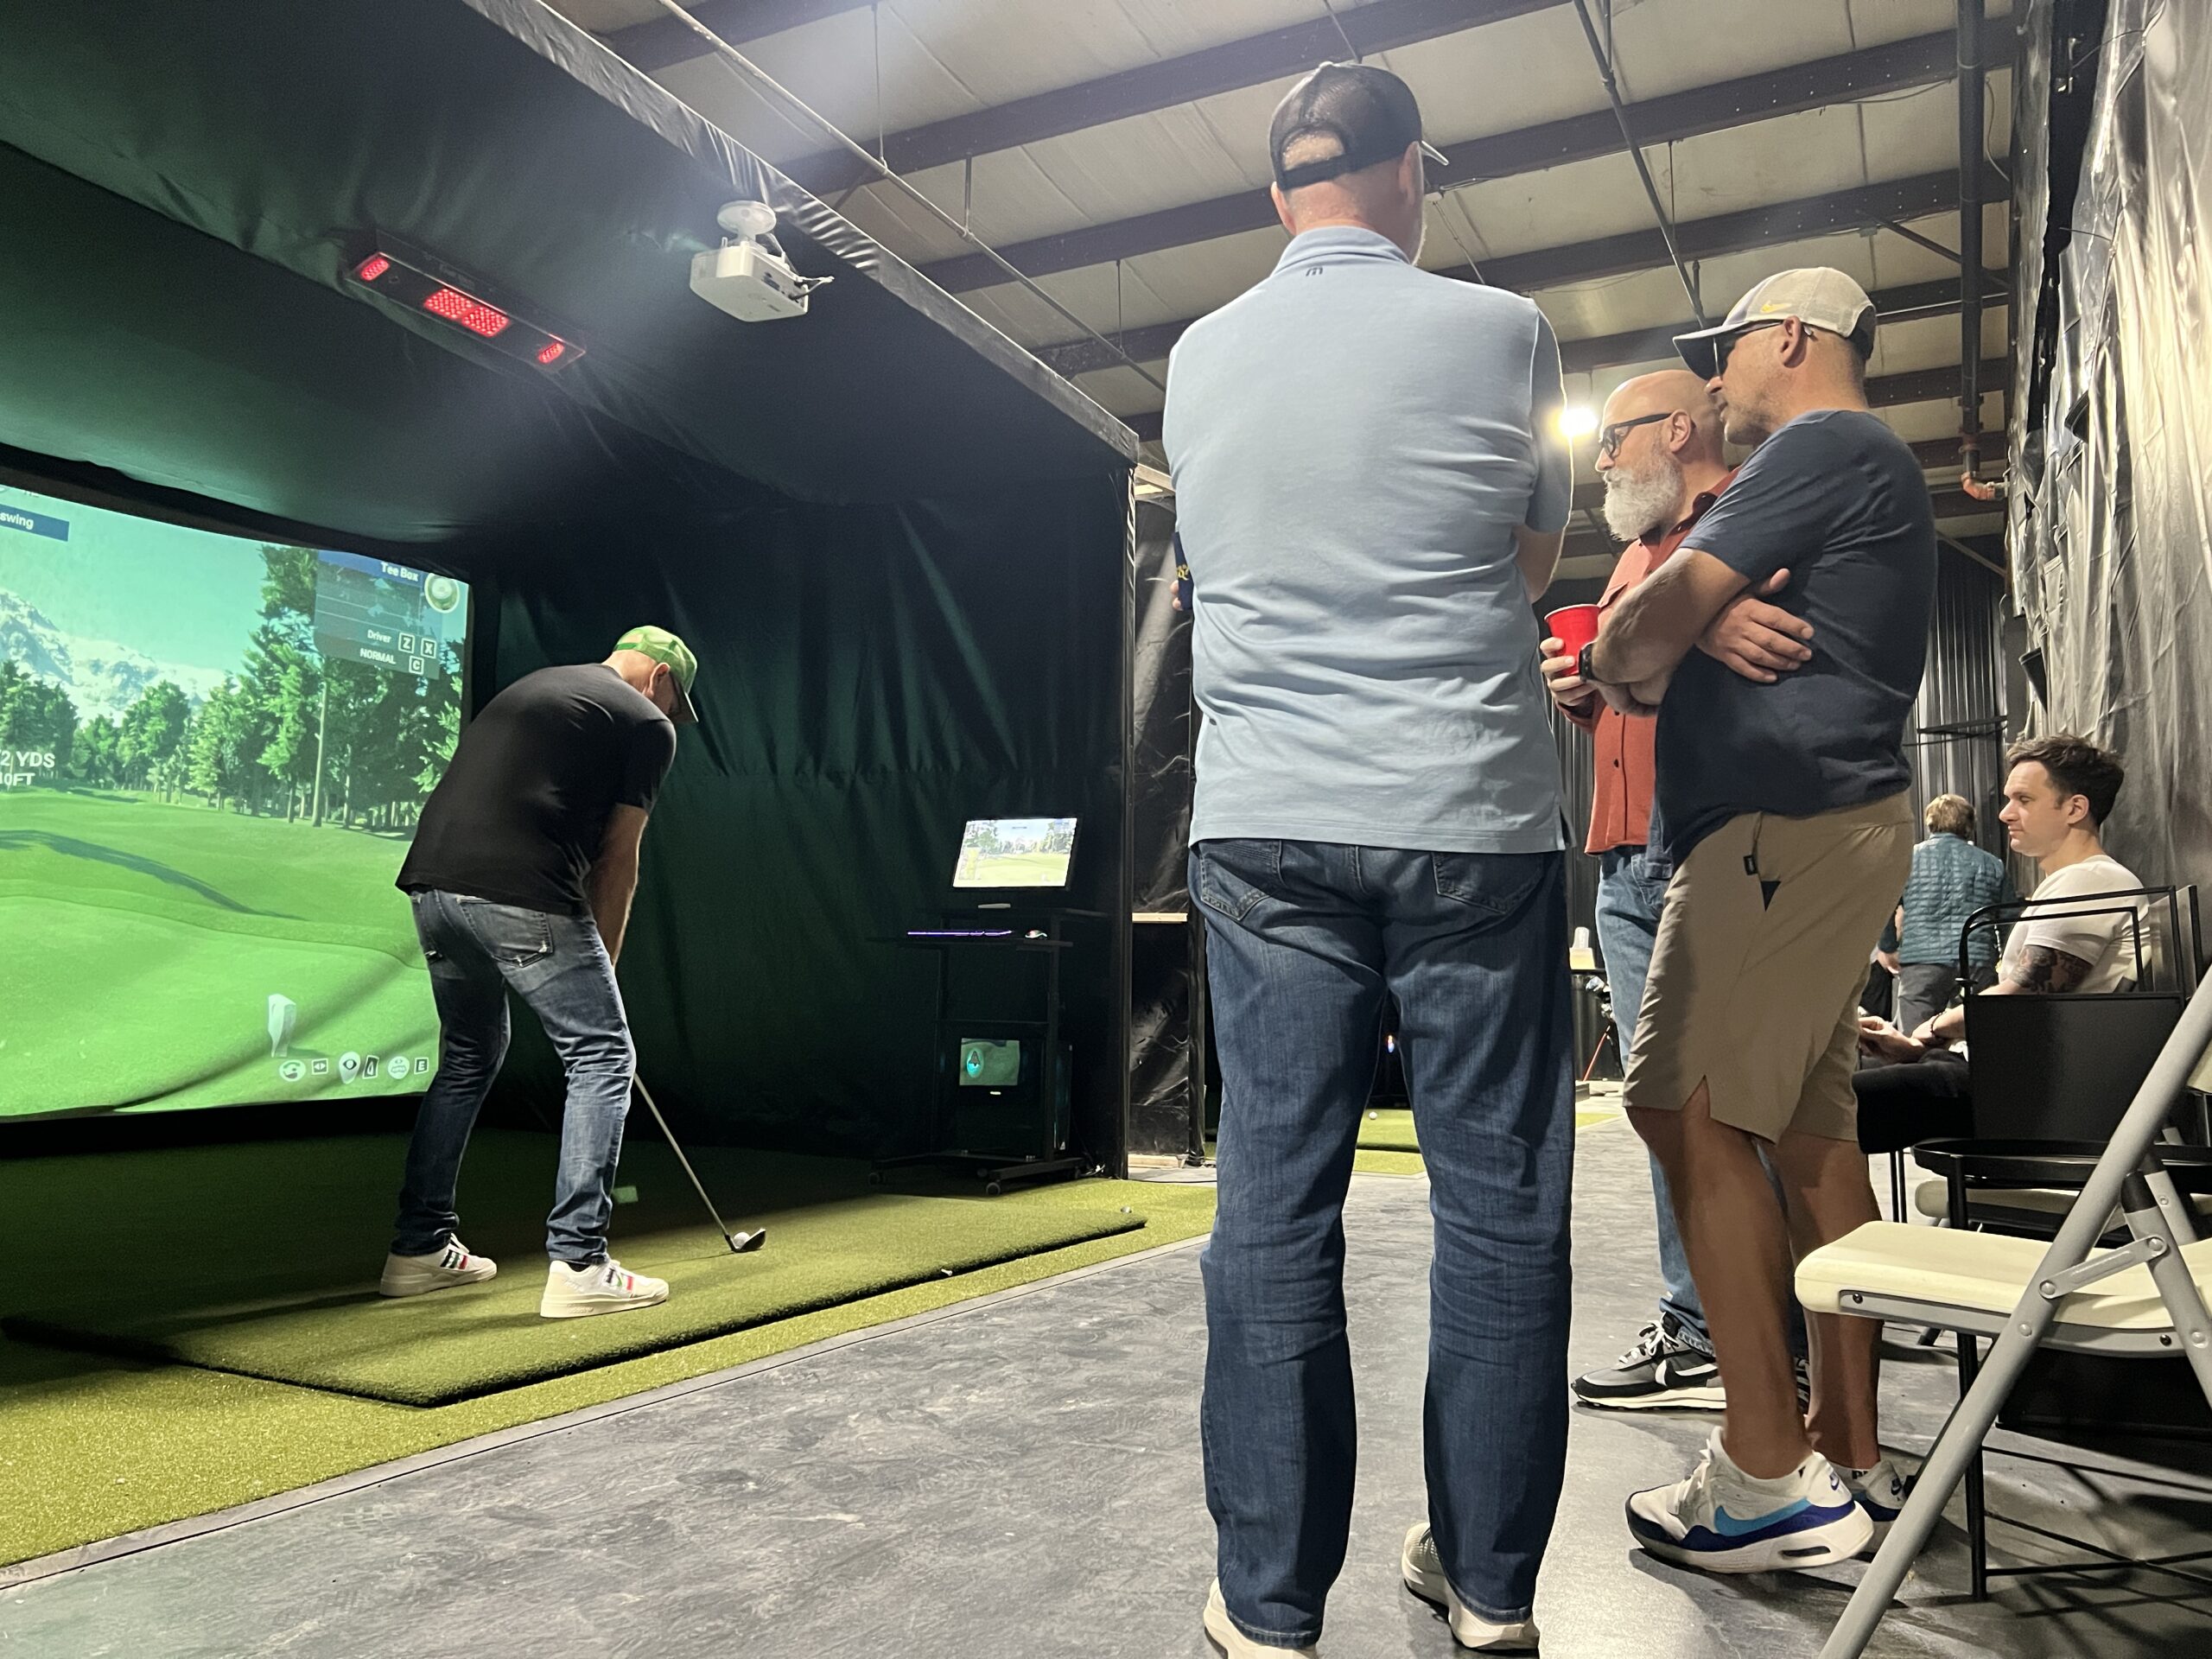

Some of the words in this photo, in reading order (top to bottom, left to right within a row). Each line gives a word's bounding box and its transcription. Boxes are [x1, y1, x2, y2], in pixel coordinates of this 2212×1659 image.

[0, 512, 34, 530] swing
[381, 562, 398, 576] Tee
[400, 569, 418, 582] Box
[367, 629, 391, 643] Driver
[403, 637, 410, 649] Z
[424, 643, 433, 654] X
[359, 648, 396, 664] NORMAL
[0, 749, 10, 766] 2
[16, 751, 55, 768] YDS
